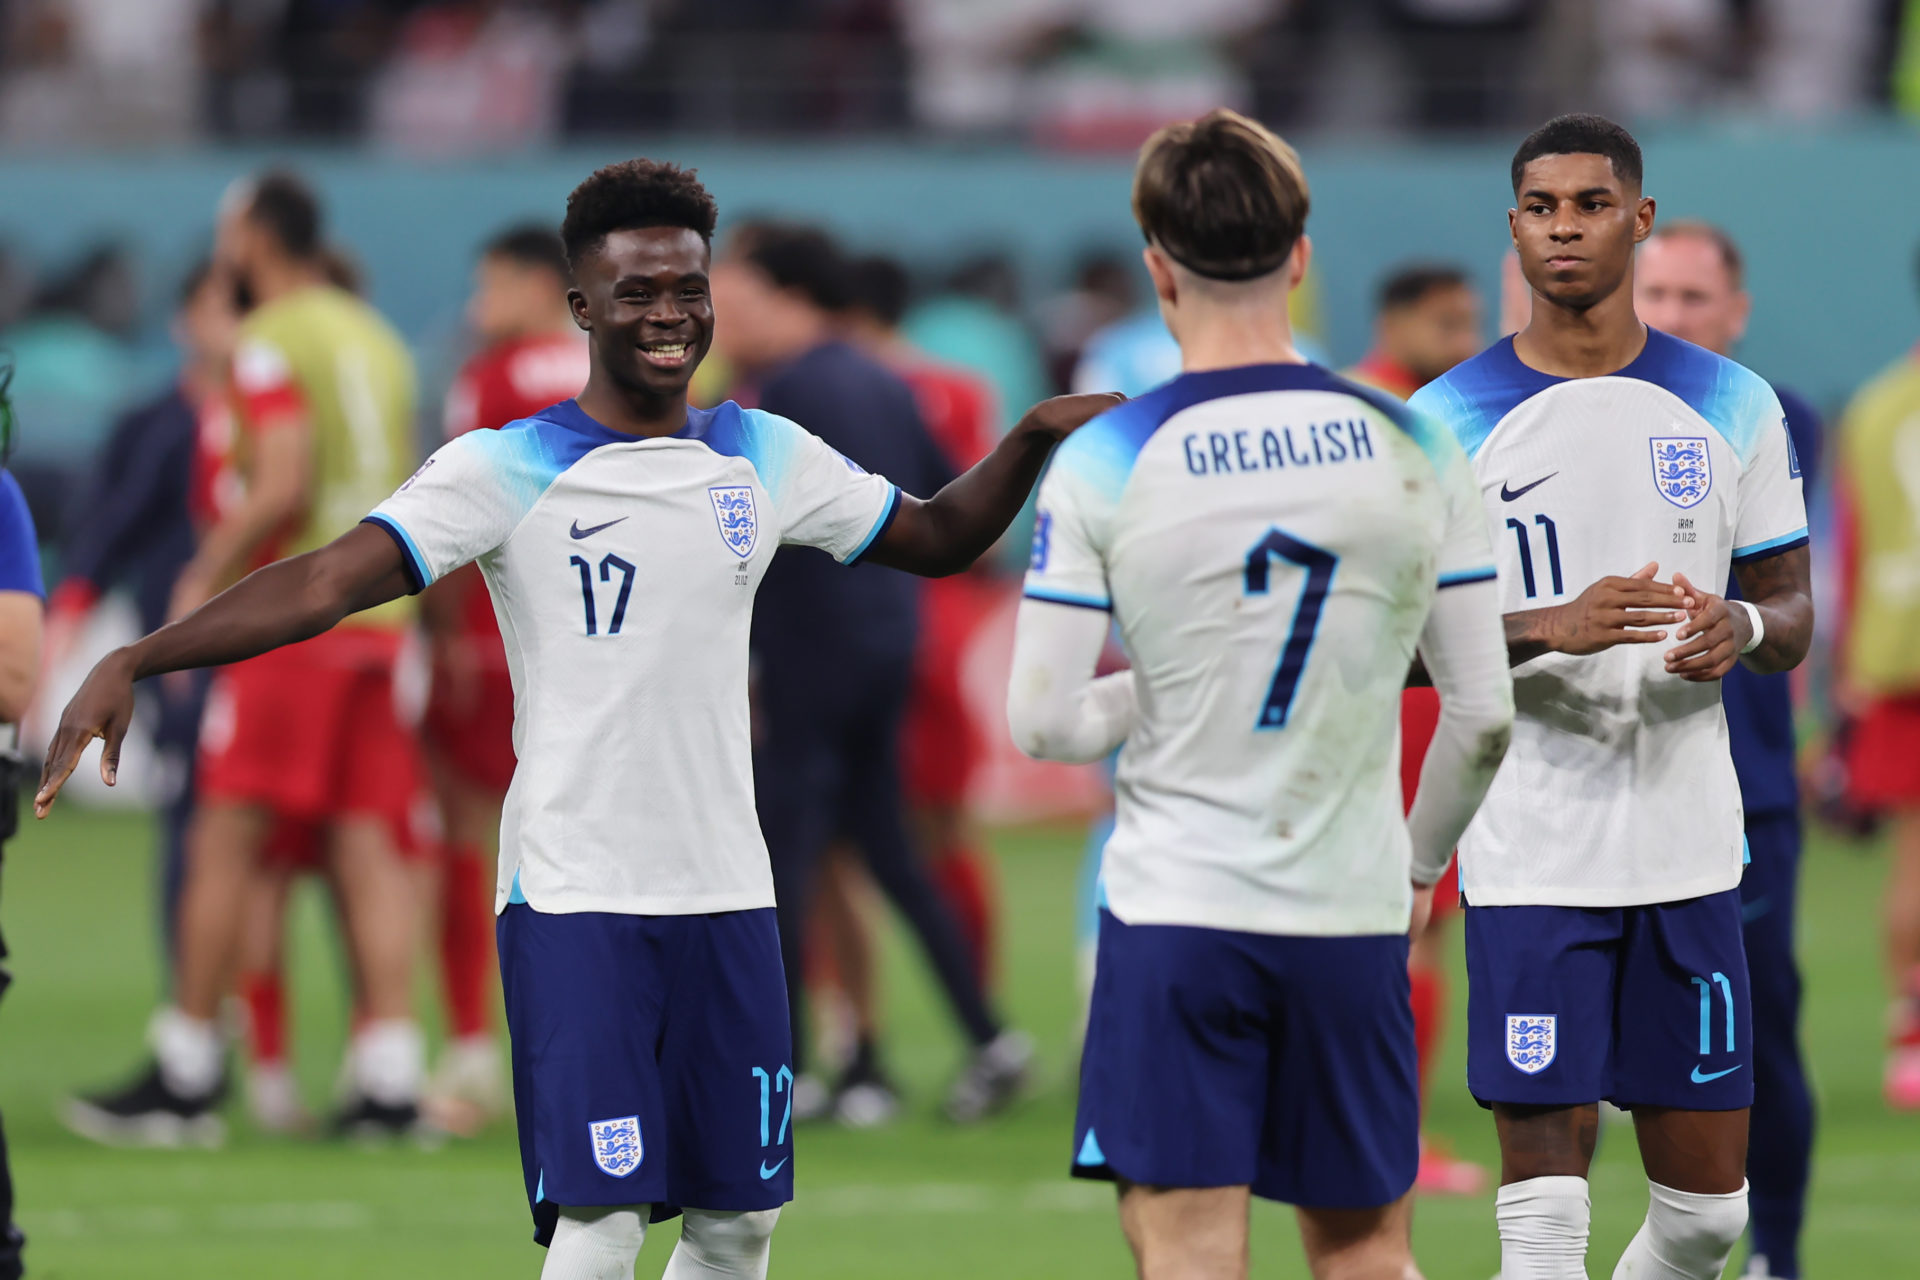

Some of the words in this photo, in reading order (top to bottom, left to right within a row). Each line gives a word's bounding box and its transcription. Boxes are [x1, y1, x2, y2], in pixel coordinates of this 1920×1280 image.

[569, 552, 636, 637] 17
[1506, 513, 1564, 599] 11
[1243, 523, 1340, 732] 7
[1690, 971, 1735, 1055] 11
[752, 1064, 794, 1147] 17
